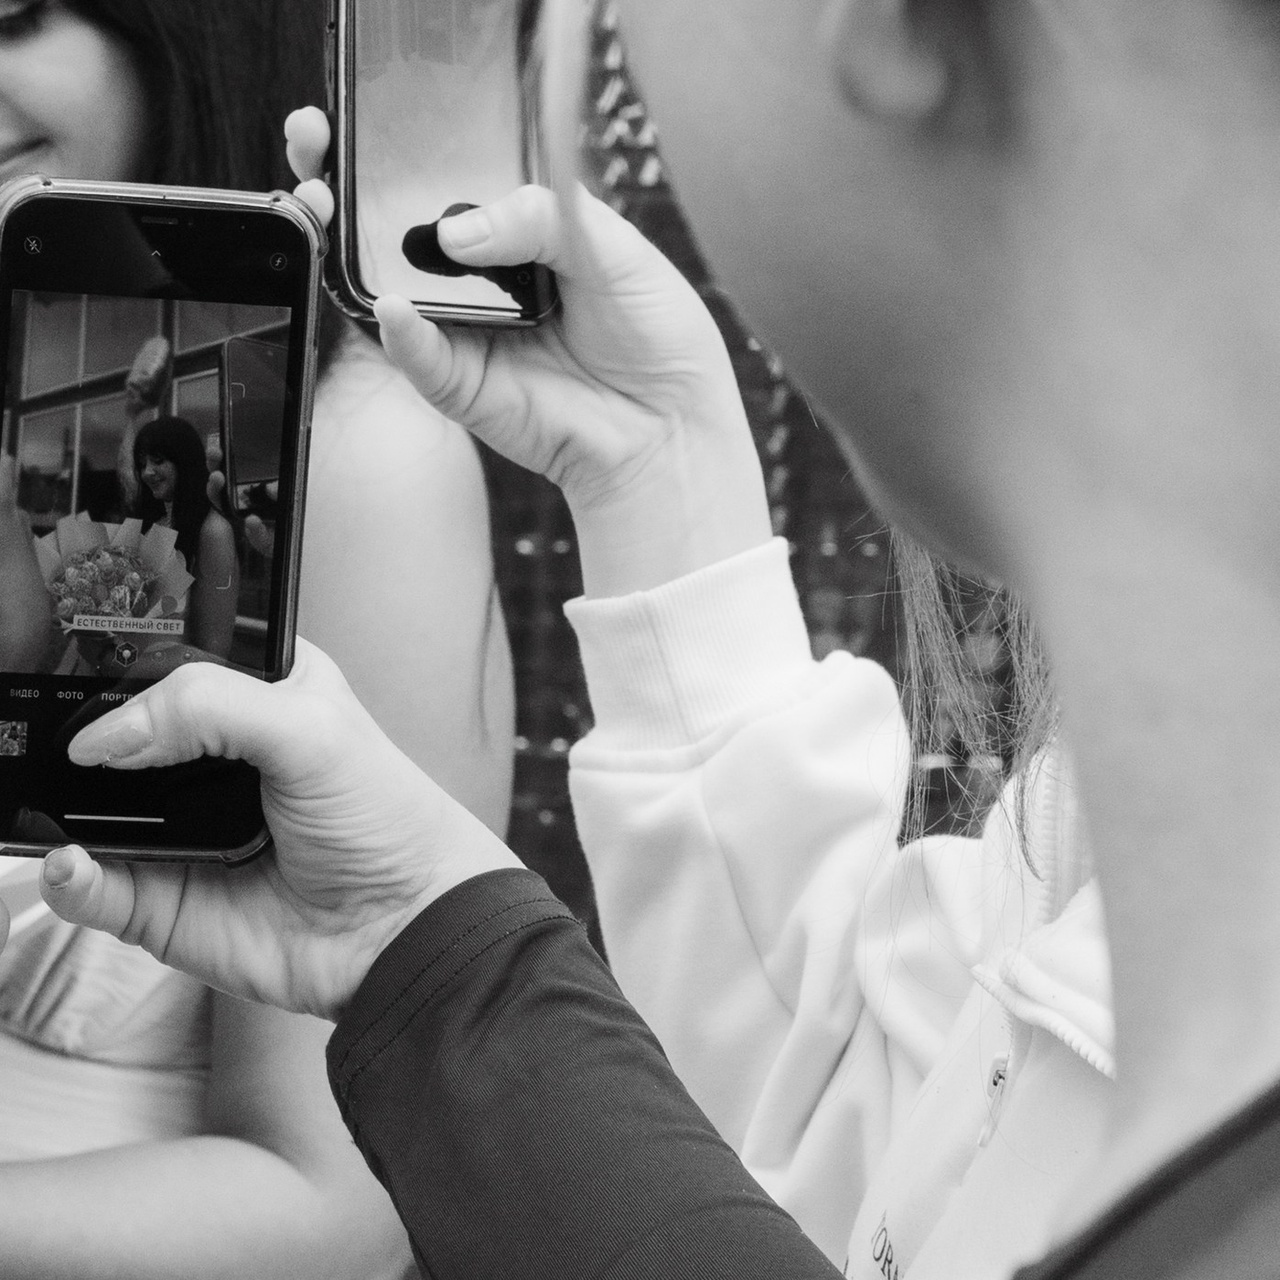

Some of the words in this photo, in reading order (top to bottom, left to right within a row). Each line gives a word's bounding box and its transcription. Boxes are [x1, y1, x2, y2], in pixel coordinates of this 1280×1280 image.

[76, 618, 154, 630] ЕСТЕСТВЕННЫЙ
[156, 622, 181, 631] СВЕТ
[10, 689, 40, 698] ВИДЕО
[56, 691, 84, 700] ФОТО
